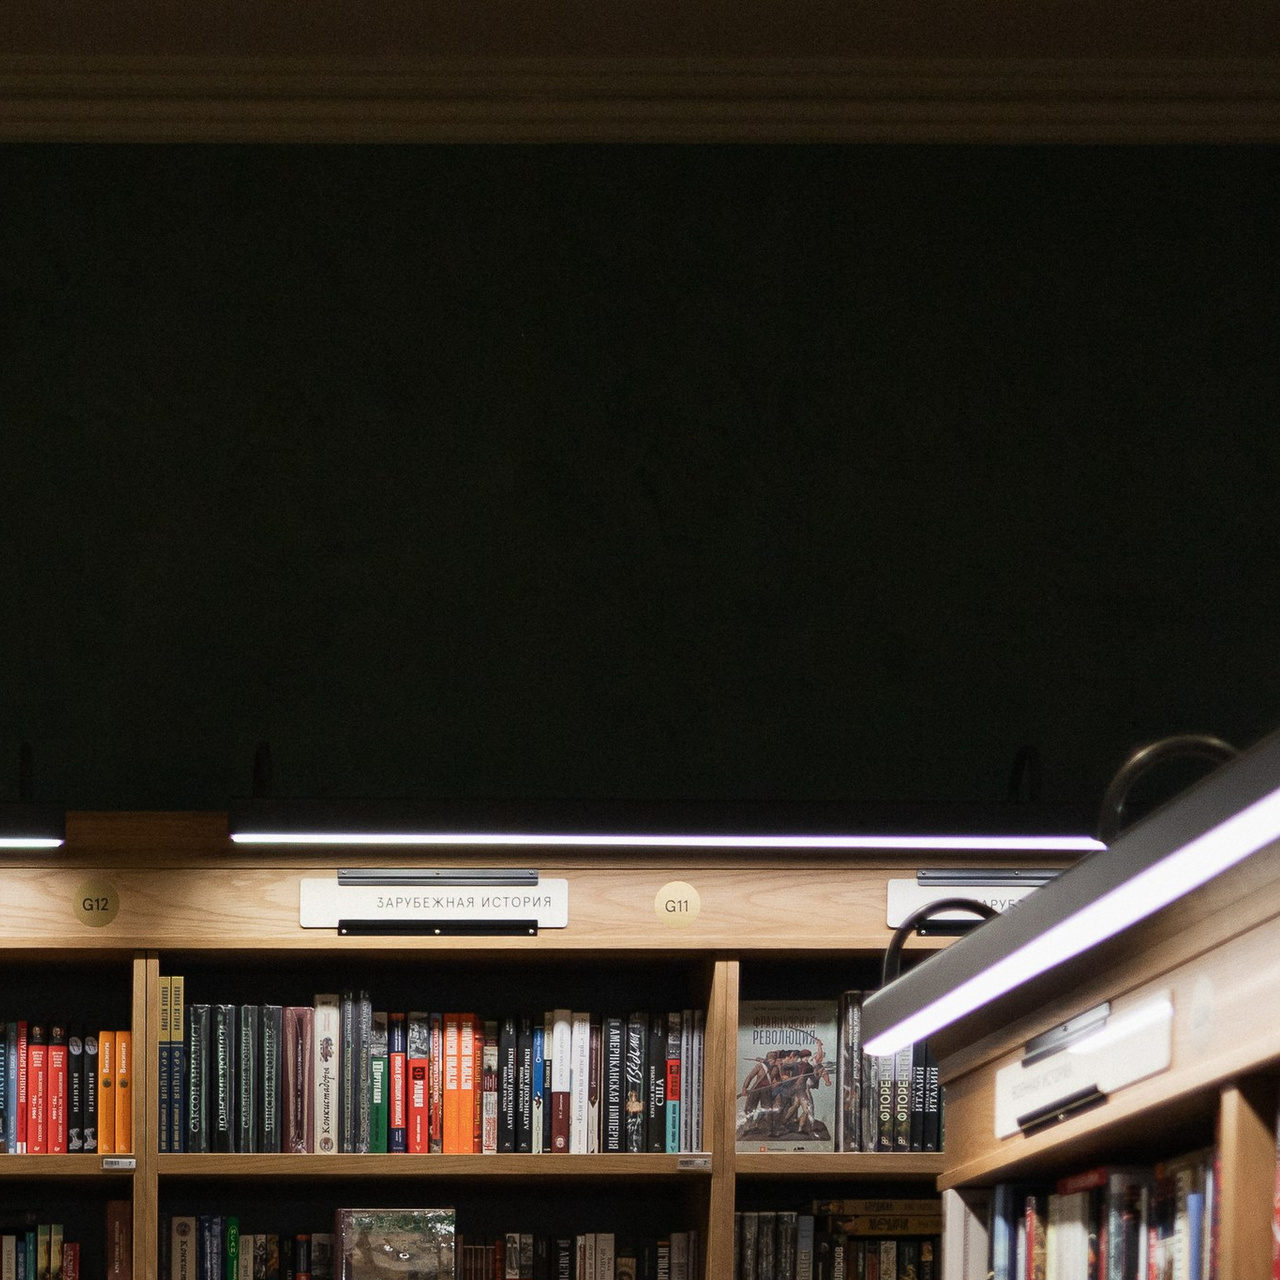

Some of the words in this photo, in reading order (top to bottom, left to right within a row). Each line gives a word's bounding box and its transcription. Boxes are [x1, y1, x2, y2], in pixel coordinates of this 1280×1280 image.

[82, 897, 109, 912] G12
[376, 896, 475, 909] ЗАРУБЕЖНАЯ
[481, 896, 552, 908] ИСТОРИЯ
[664, 899, 690, 913] G11
[753, 1017, 816, 1028] ФРАНЦУЗСКАЯ
[753, 1030, 815, 1046] РЕВОЛЮЦИЯ
[191, 1023, 200, 1084] АННАЛИСТ
[609, 1029, 619, 1102] АМЕРИКАНСКАЯ
[191, 1087, 200, 1132] САКСОН
[219, 1078, 227, 1131] ПОЛЬСКИЕ
[319, 1067, 334, 1134] Конкистадоры
[656, 1078, 664, 1106] США
[916, 1067, 924, 1112] ИТАЛИИ
[930, 1067, 938, 1112] ИТАЛИИ
[609, 1106, 619, 1149] ИМПЕРИЯ
